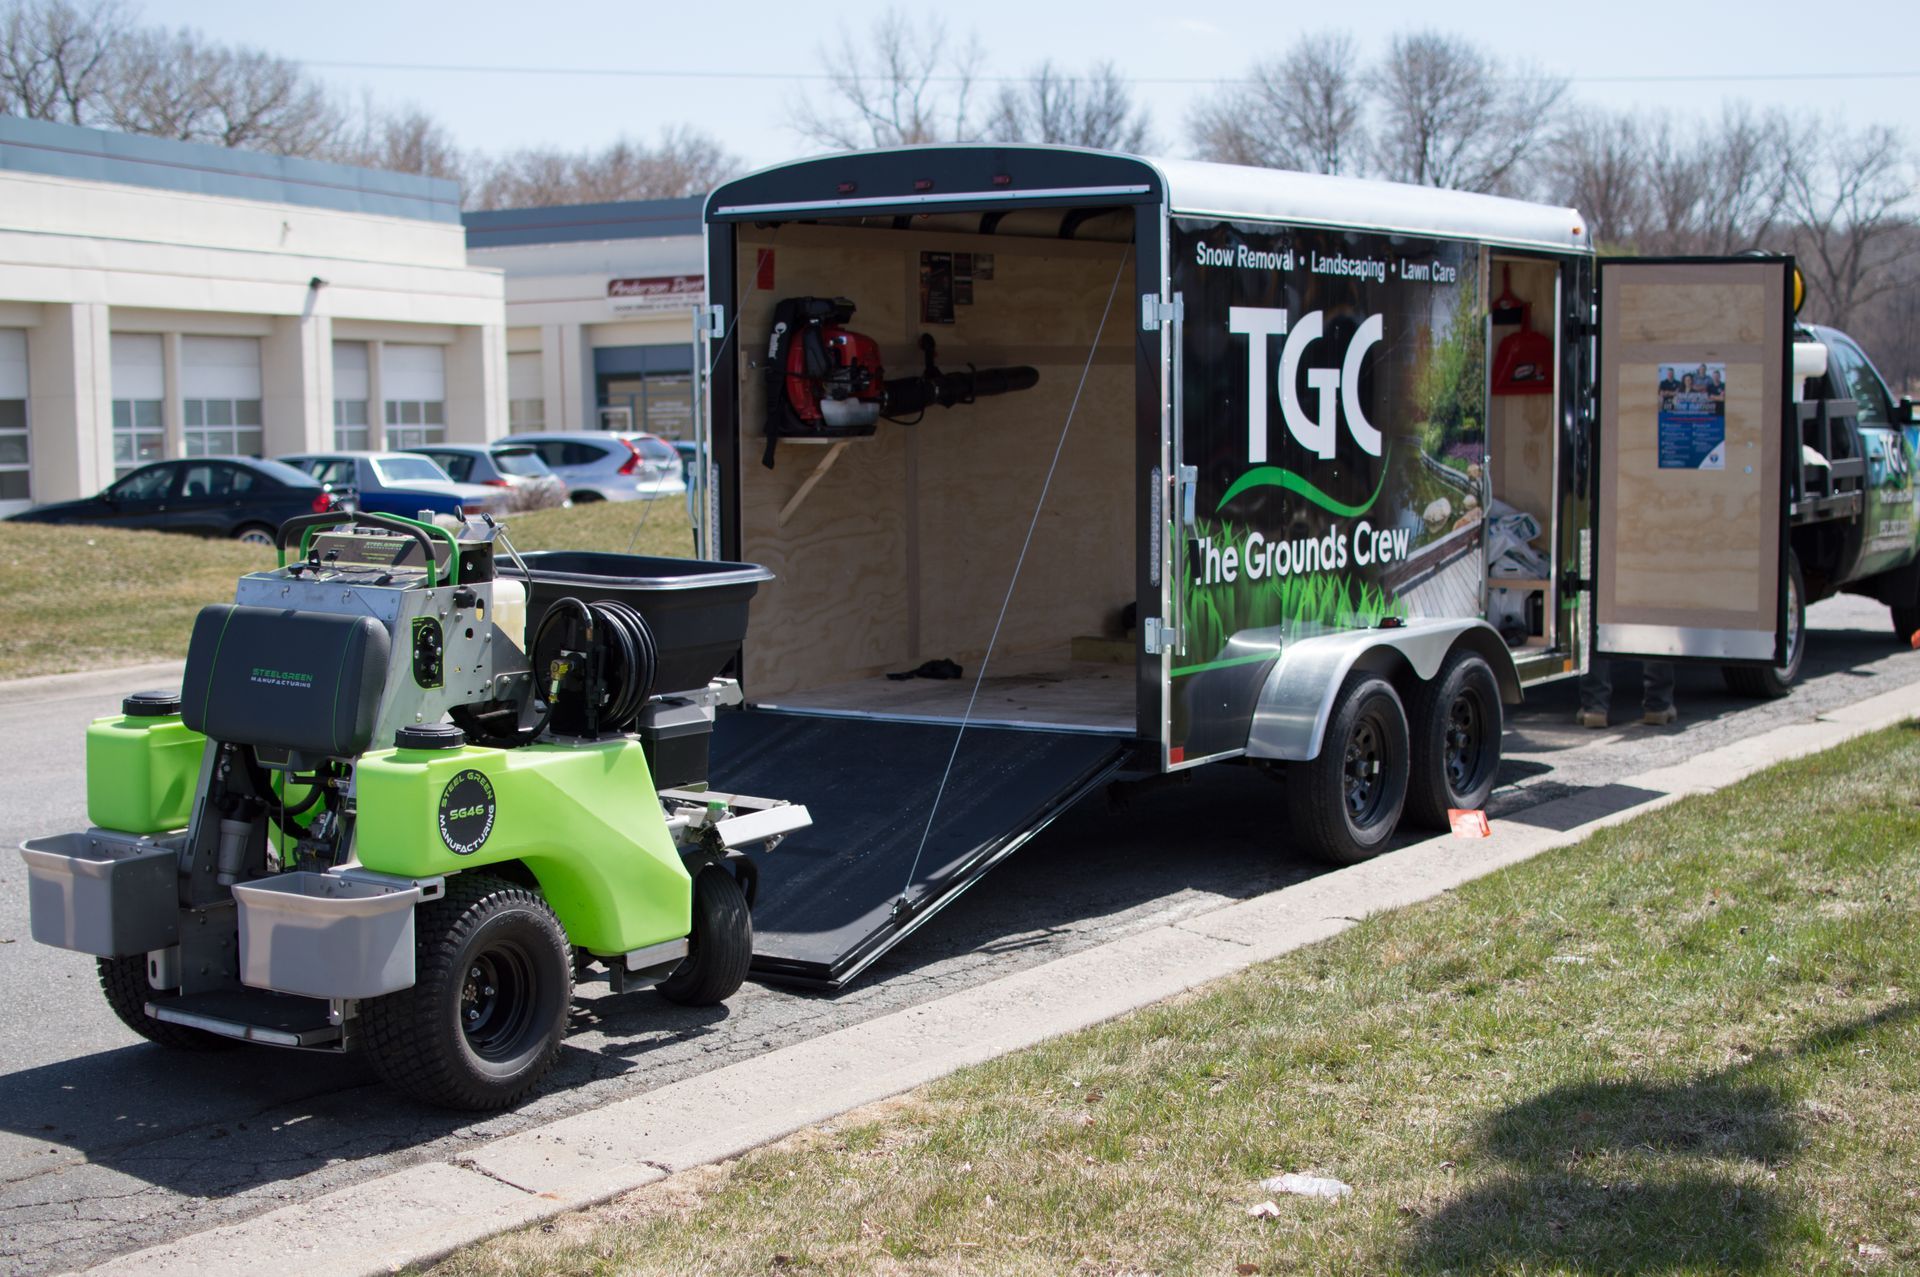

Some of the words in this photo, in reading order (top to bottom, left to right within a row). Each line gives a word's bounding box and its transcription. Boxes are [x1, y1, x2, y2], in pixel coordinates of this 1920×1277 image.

[1196, 240, 1234, 267] Snow
[1237, 245, 1294, 271] Removal
[1311, 250, 1385, 283] Landscaping
[1401, 258, 1429, 281] Lawn
[1432, 261, 1456, 283] Care
[1229, 306, 1383, 463] TGC
[1245, 523, 1347, 580] Grounds
[1353, 520, 1410, 566] Crew
[250, 676, 311, 688] MANUFACTURING
[252, 668, 313, 682] STEELGREEN
[441, 776, 465, 808] STEEL
[466, 772, 493, 800] GREEN
[440, 804, 495, 853] MANUFACTURING
[449, 804, 485, 821] SG46
